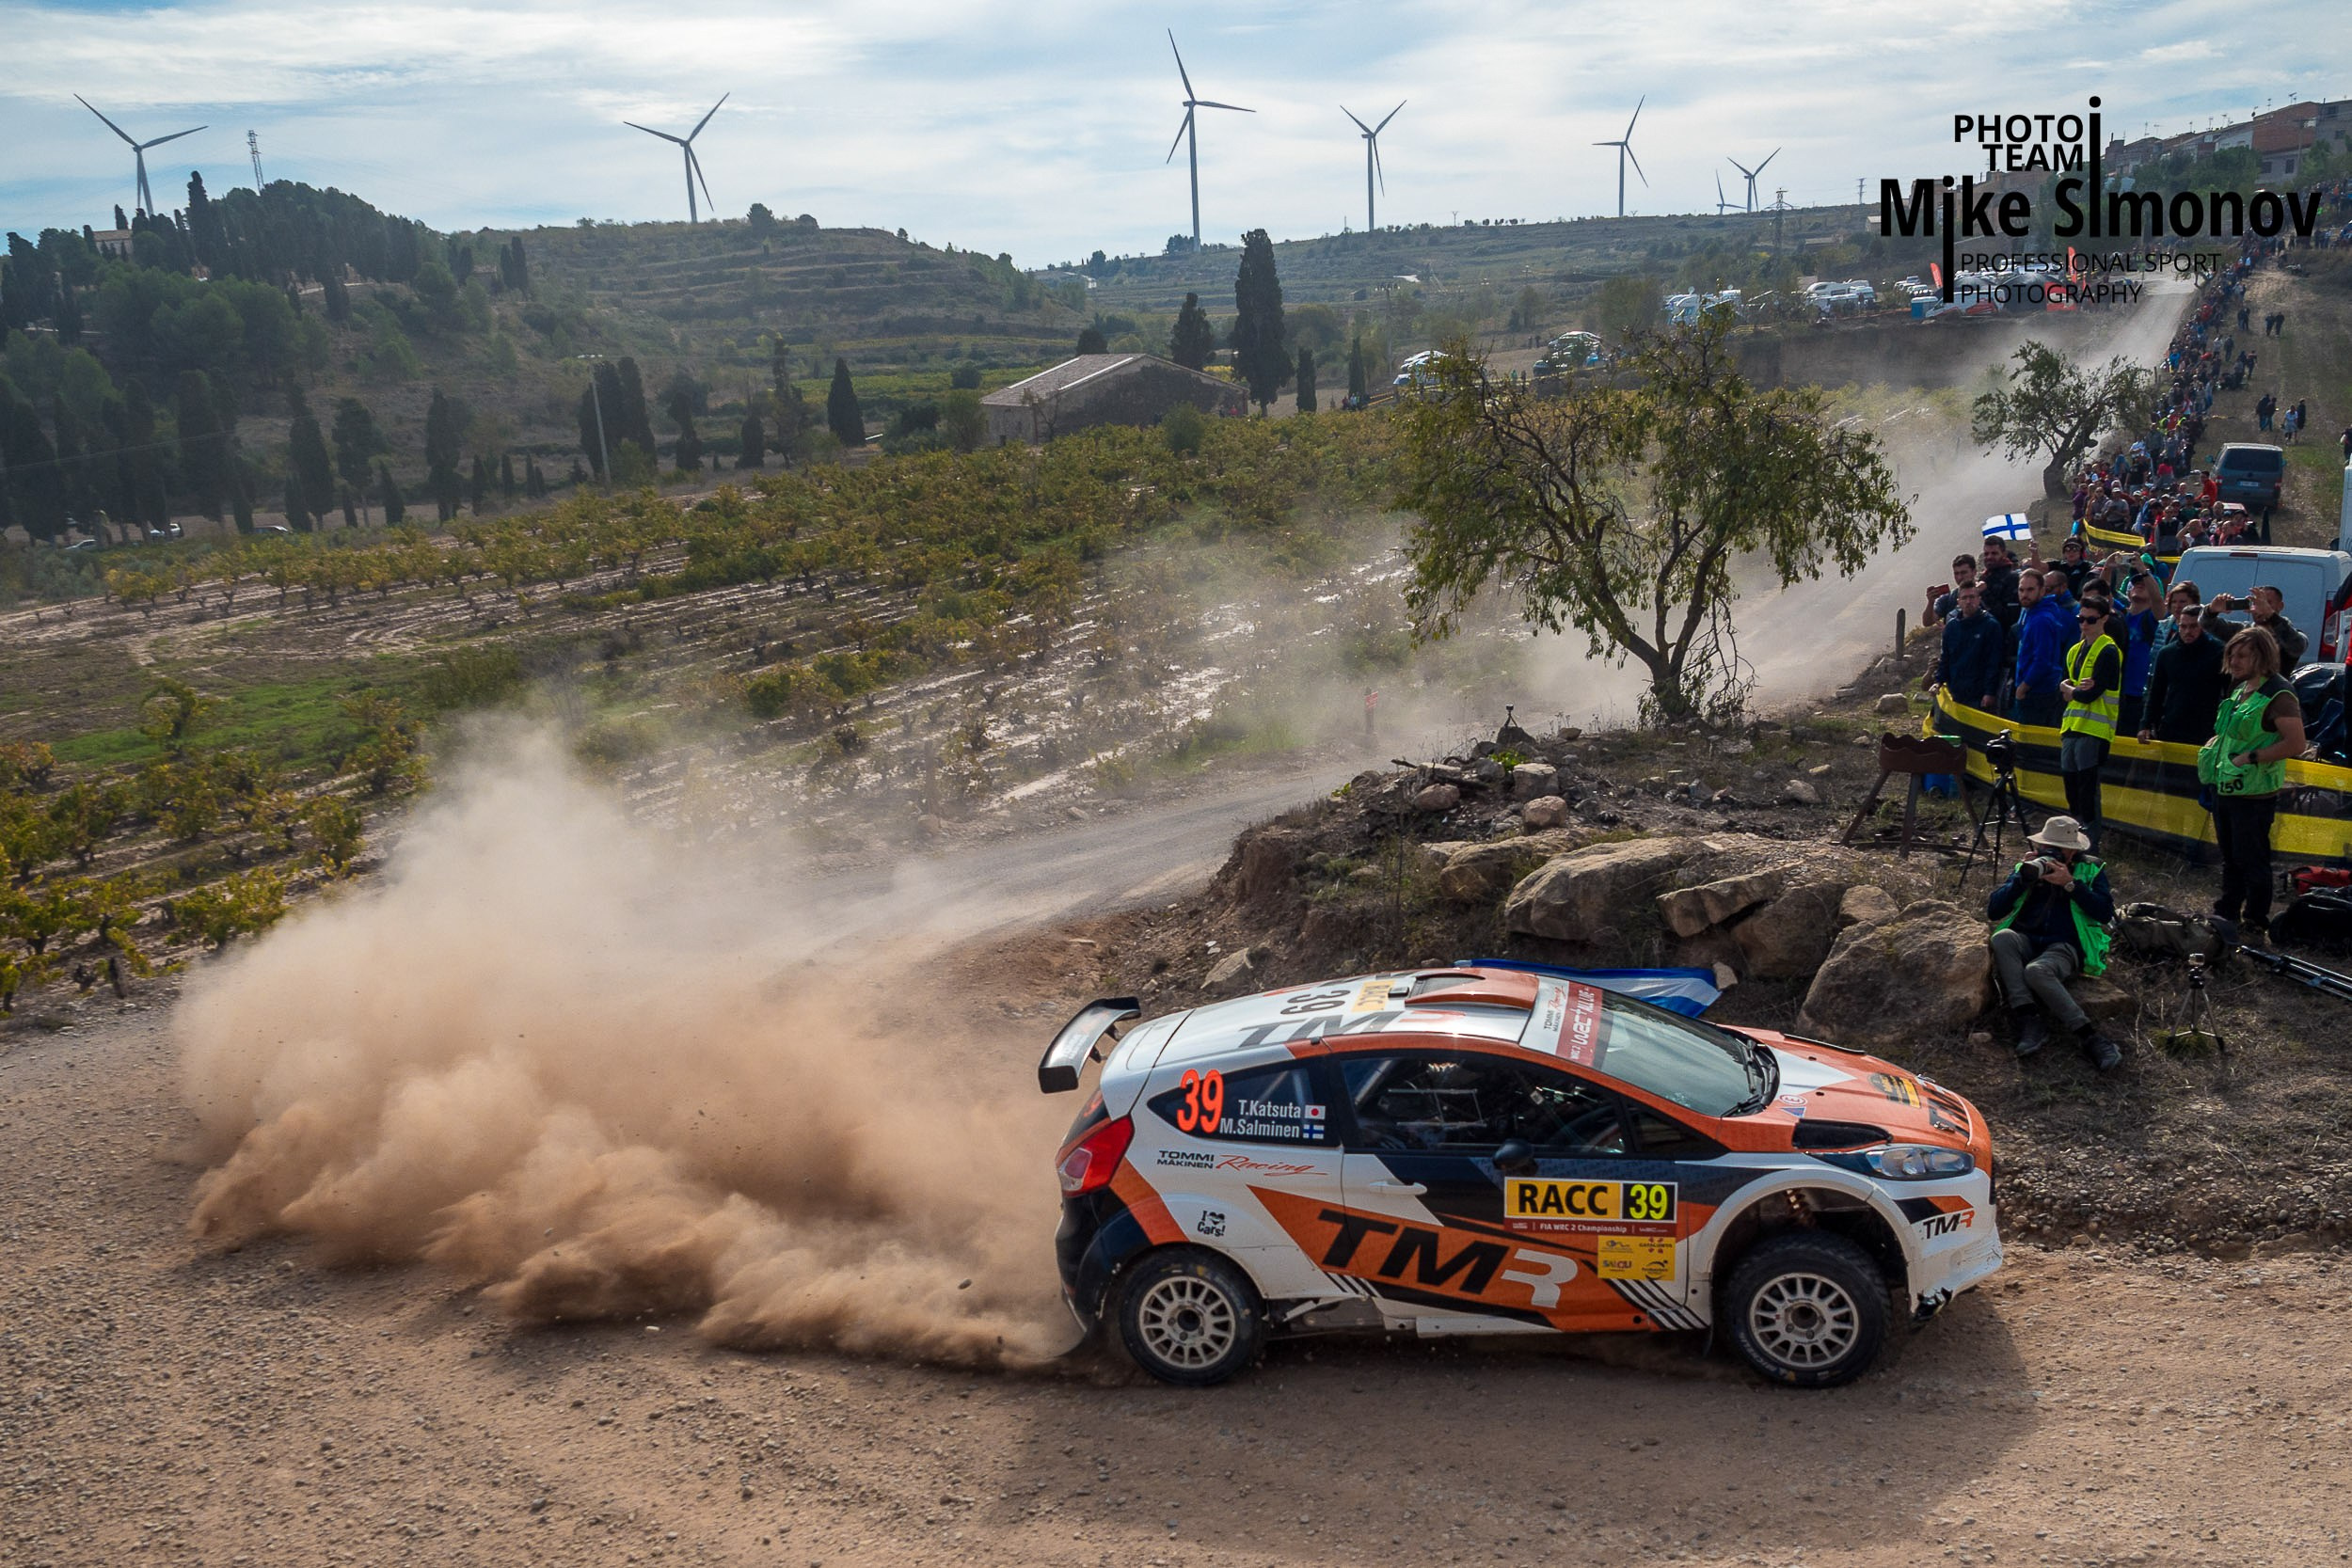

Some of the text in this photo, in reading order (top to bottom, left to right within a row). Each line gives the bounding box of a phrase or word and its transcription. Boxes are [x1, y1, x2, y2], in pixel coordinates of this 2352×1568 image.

[1177, 1069, 1223, 1133] 39
[1238, 1100, 1301, 1118] T.Katsuta
[1219, 1117, 1300, 1138] M.Salminen
[1158, 1150, 1215, 1162] TOMMI
[1216, 1155, 1328, 1177] Racing
[1518, 1183, 1608, 1215] RACC
[1629, 1184, 1668, 1220] 39
[1197, 1221, 1226, 1237] Cars!
[1578, 1225, 1628, 1233] Championship
[1922, 1210, 1975, 1240] TMR
[1317, 1209, 1579, 1308] TMR
